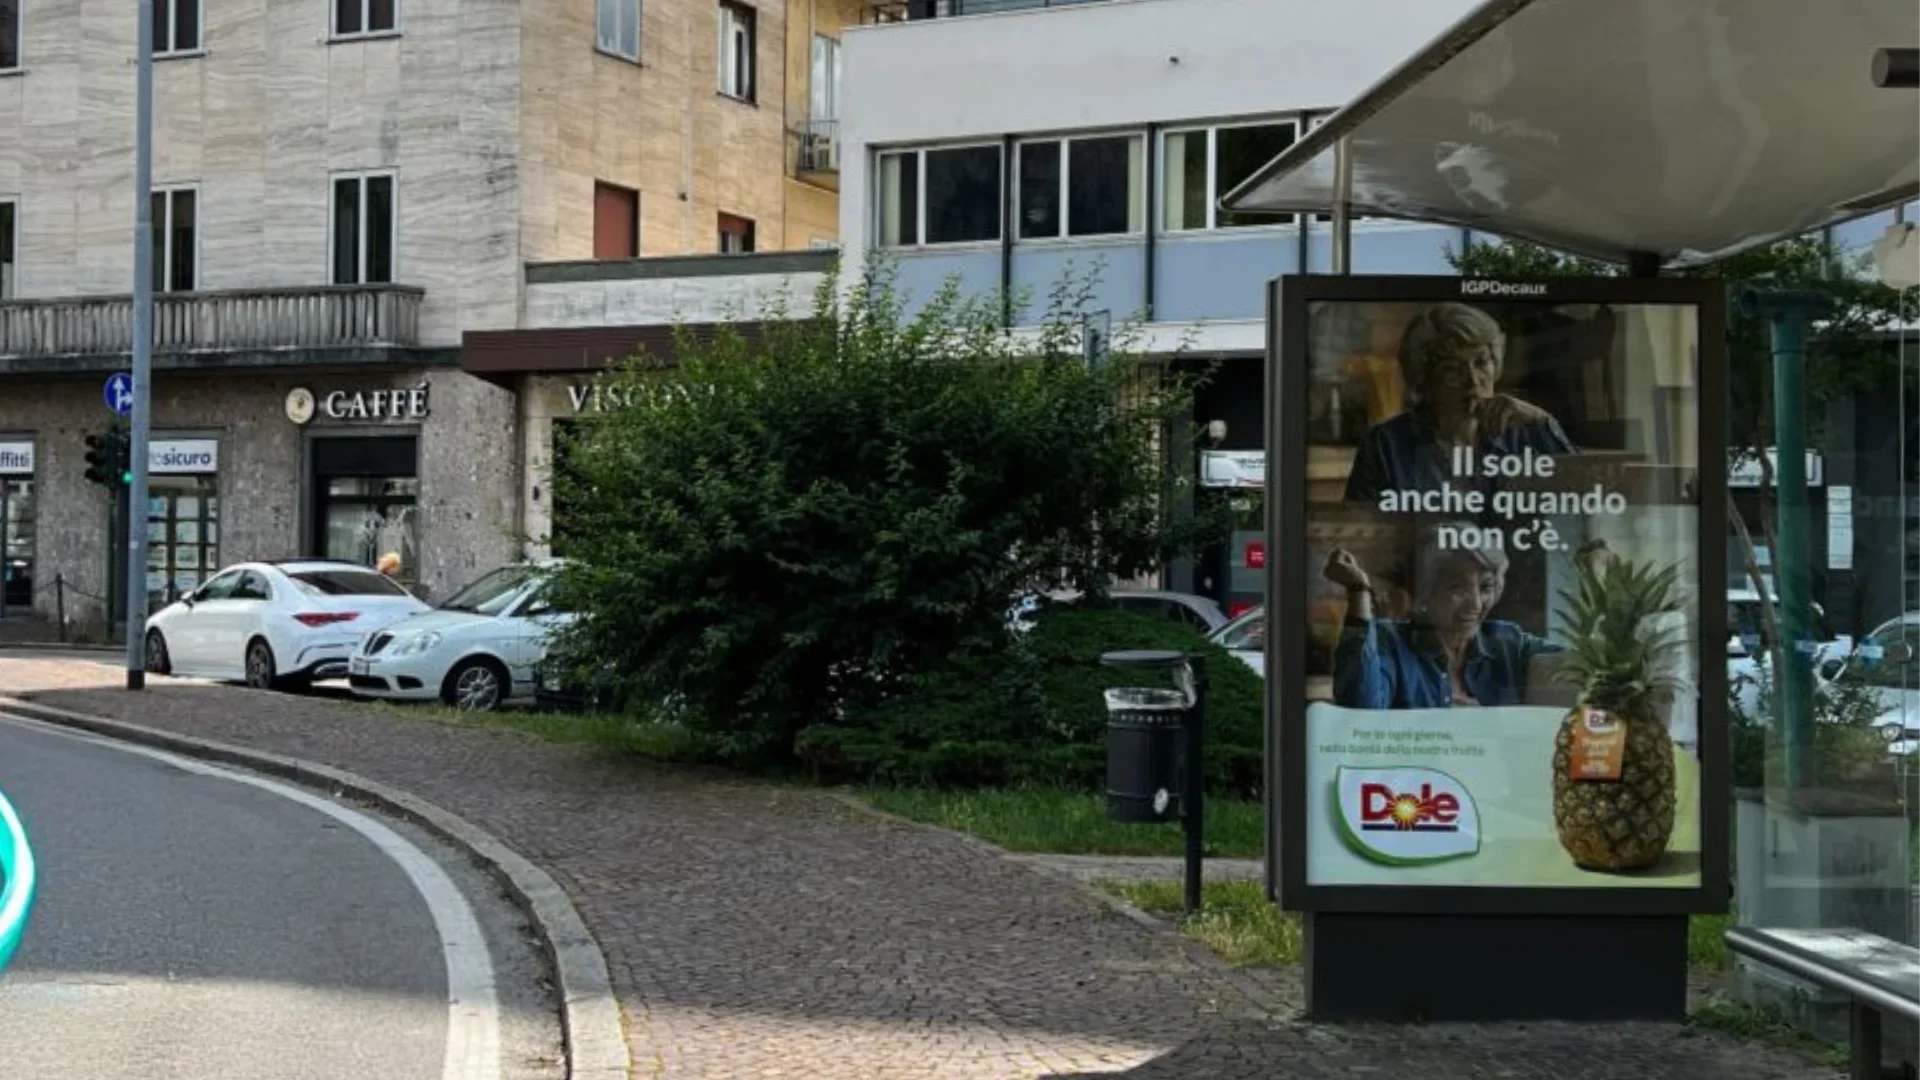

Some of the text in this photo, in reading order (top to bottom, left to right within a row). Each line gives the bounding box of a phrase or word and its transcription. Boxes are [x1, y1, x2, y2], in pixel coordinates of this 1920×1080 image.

[1461, 280, 1548, 295] IGPDecaux
[1452, 446, 1556, 477] Il sole
[1378, 481, 1627, 520] anche quando
[1437, 519, 1569, 551] non c'è.
[1361, 783, 1460, 823] Dole
